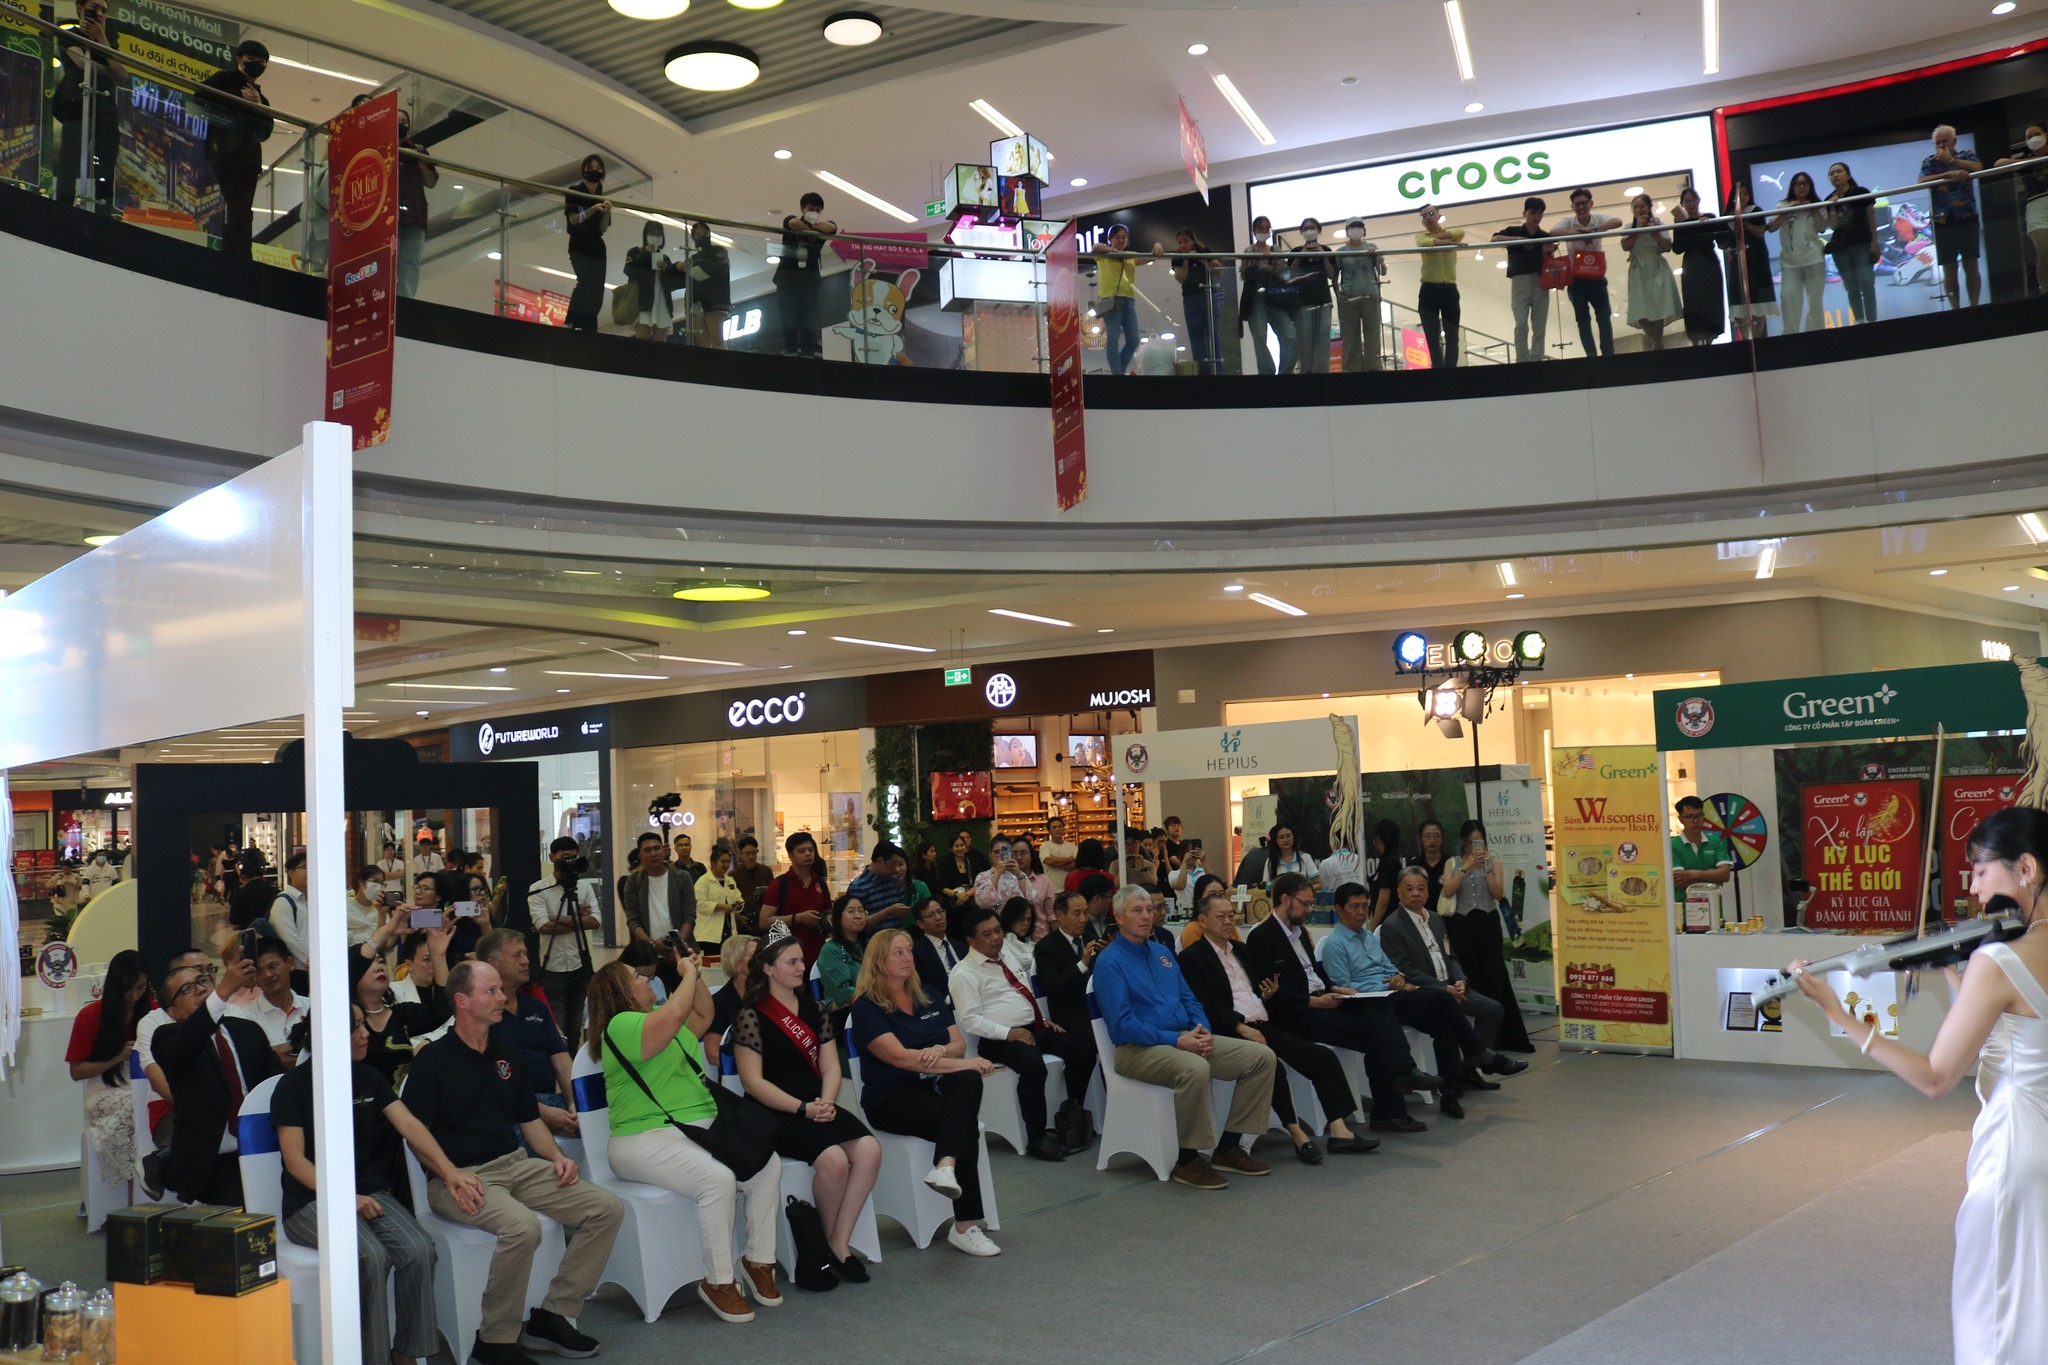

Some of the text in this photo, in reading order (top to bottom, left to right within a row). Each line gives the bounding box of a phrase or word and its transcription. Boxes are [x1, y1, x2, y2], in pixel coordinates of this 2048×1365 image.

[117, 7, 232, 61] Đi Grab bao rẻ
[193, 15, 222, 36] Mall
[178, 62, 211, 81] chuyể
[1398, 151, 1551, 199] crocs
[1089, 689, 1150, 707] MUJOSH
[728, 692, 805, 728] ecco
[495, 726, 559, 743] FUTUREWORLD
[1207, 756, 1258, 771] HEPIUS
[1489, 808, 1520, 817] HEPIUS
[1574, 798, 1655, 823] Wisconsin
[1629, 823, 1646, 832] Hoa
[1488, 833, 1502, 844] ÂM
[1520, 834, 1534, 844] CK
[1854, 844, 1891, 868] LỤC
[1818, 865, 1853, 891] THẾ
[1860, 867, 1901, 891] GIỚI
[1872, 896, 1890, 907] GIA
[781, 1016, 813, 1048] ALICE IN
